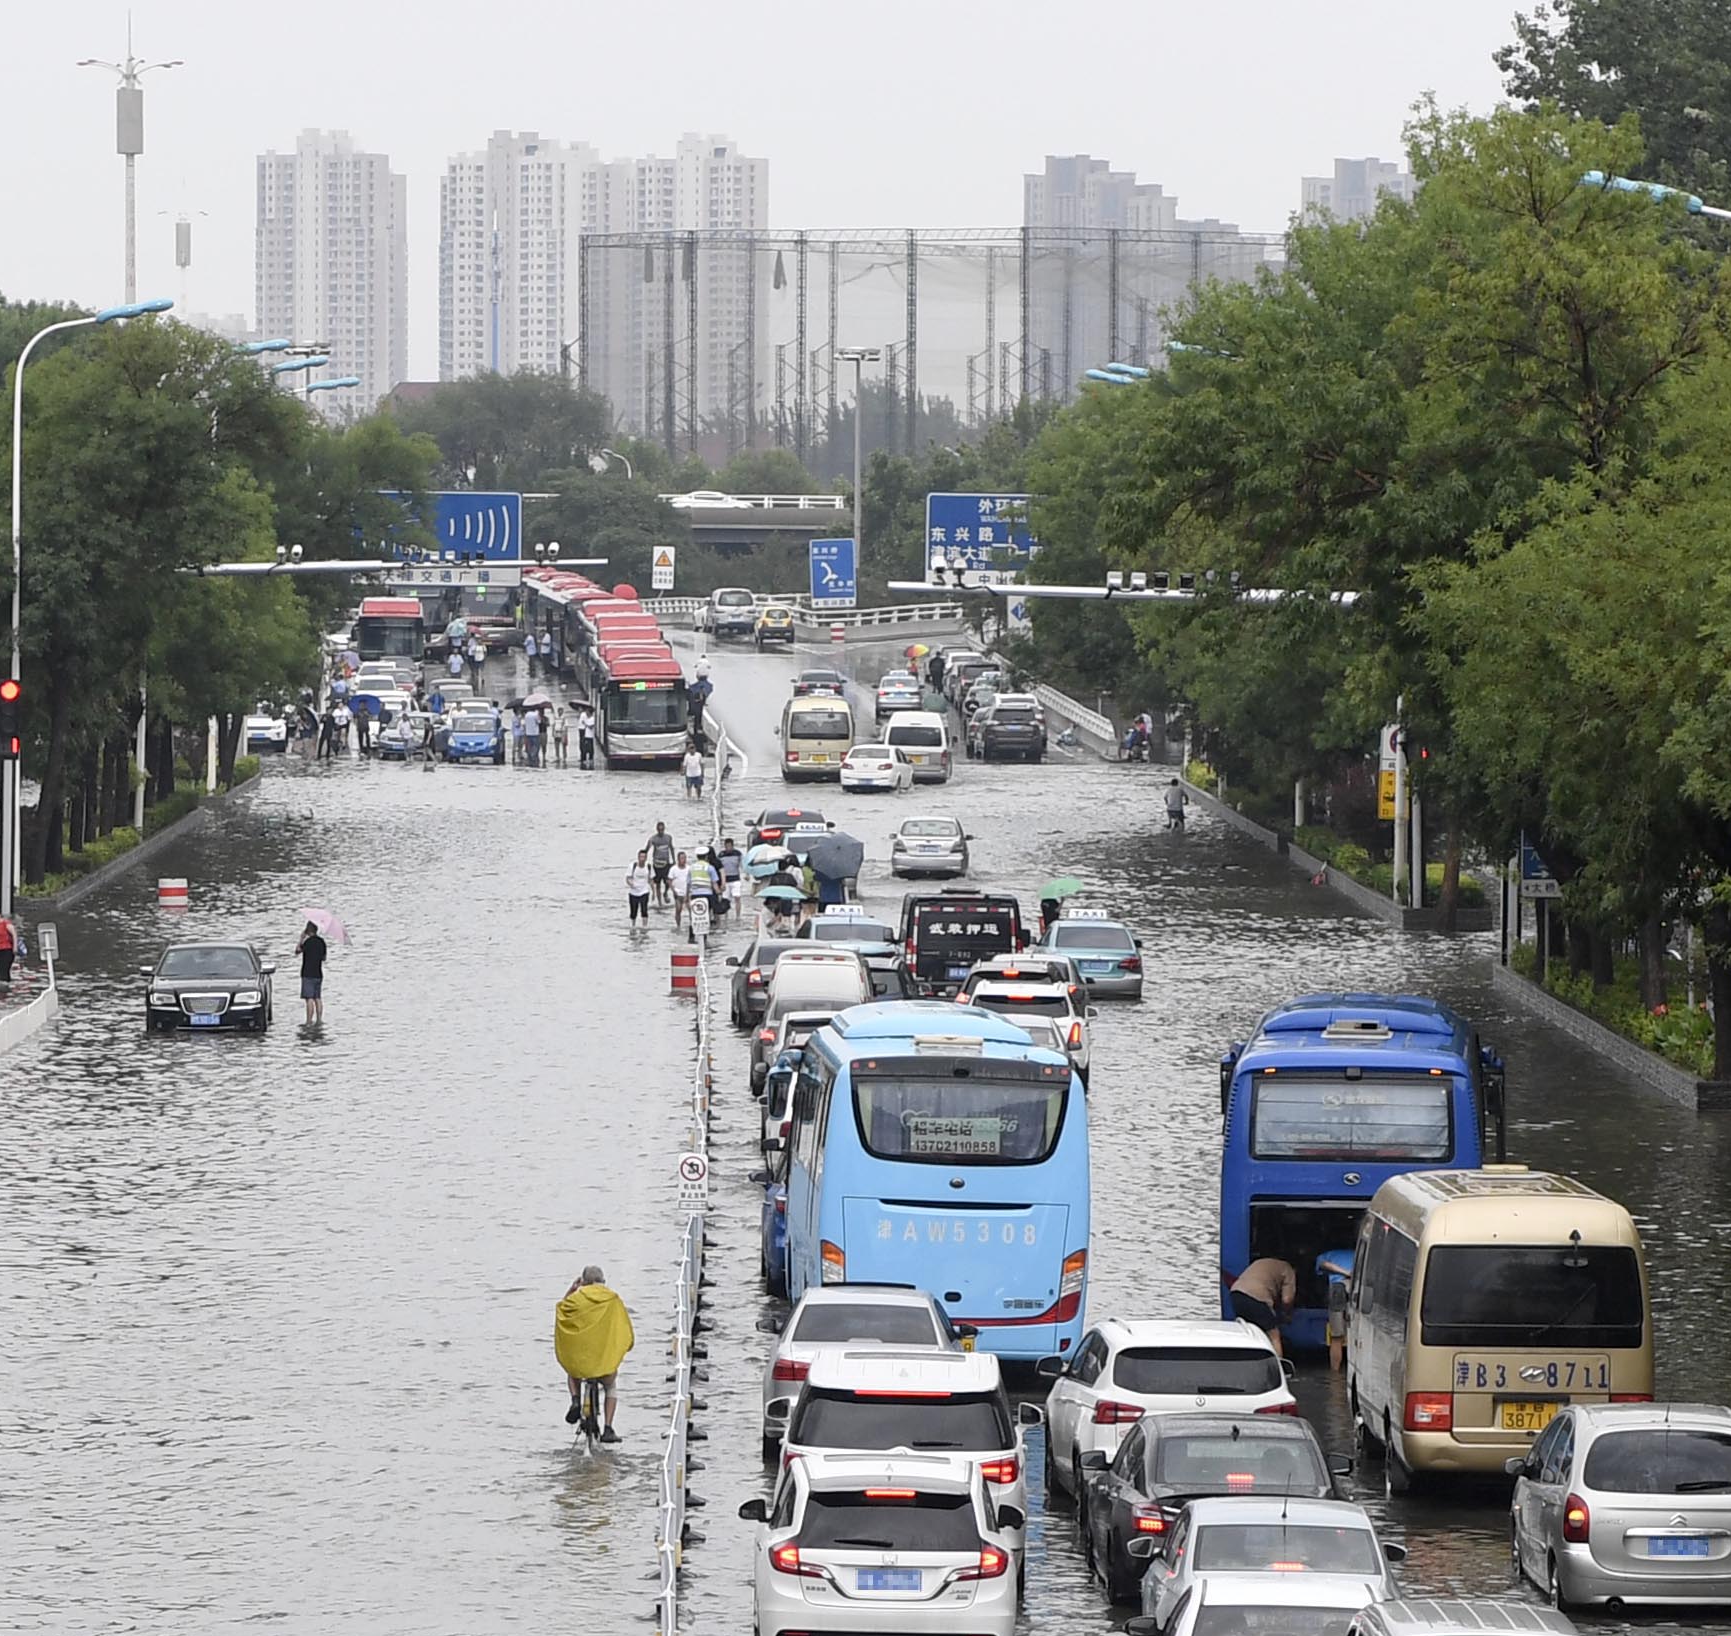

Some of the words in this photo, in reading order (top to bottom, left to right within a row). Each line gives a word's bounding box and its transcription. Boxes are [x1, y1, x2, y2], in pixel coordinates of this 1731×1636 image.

[930, 527, 994, 542] 东兴路
[928, 922, 1000, 935] 武装押运
[913, 1121, 973, 1136] 租车电话
[915, 1141, 997, 1153] 13702110858
